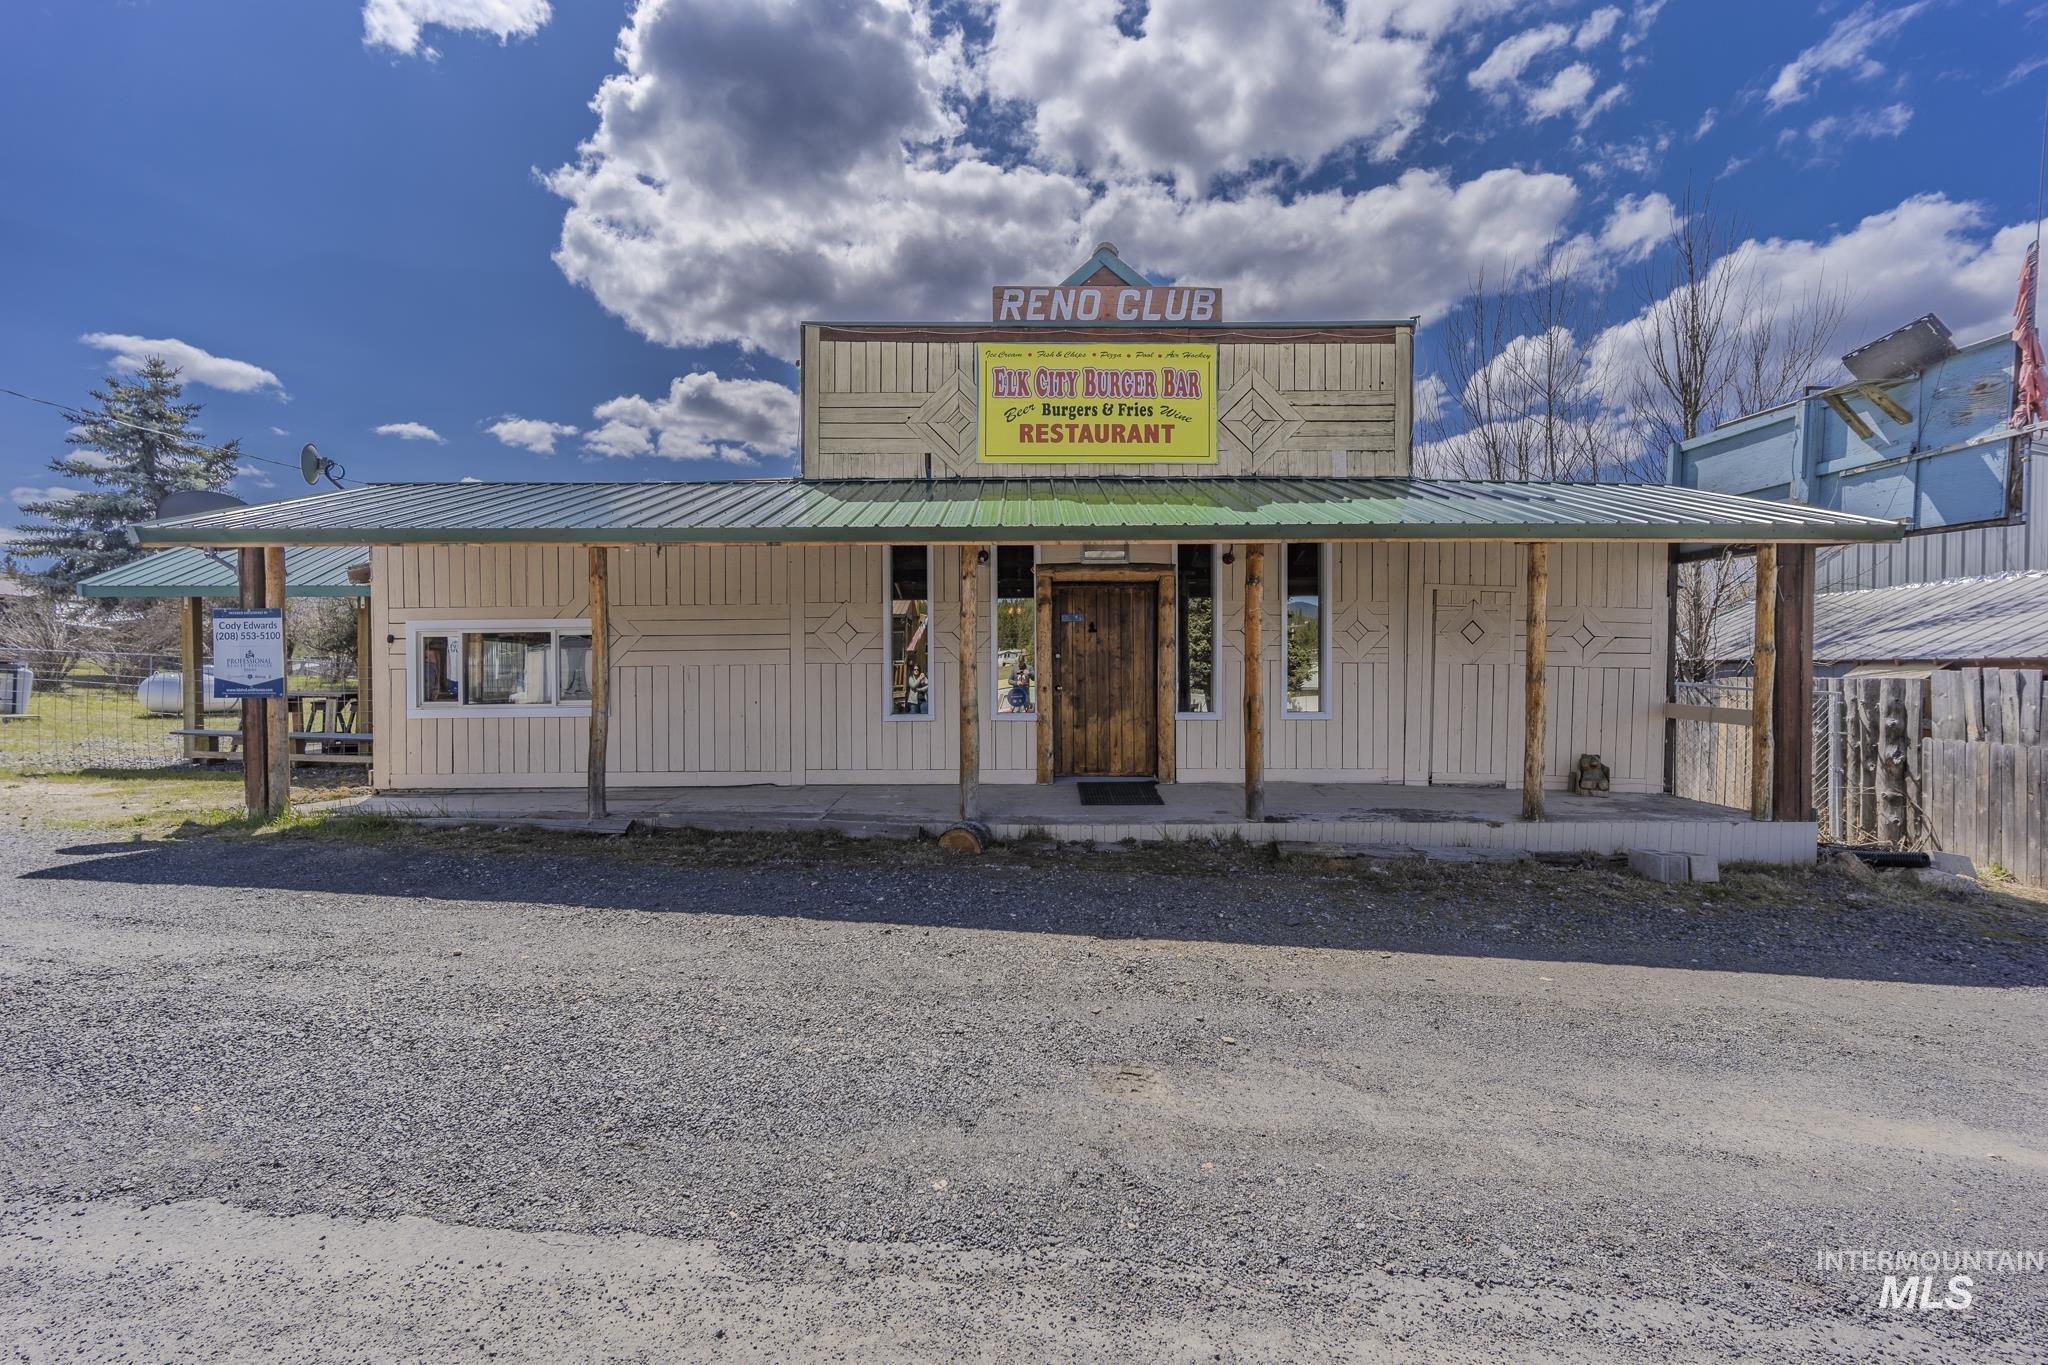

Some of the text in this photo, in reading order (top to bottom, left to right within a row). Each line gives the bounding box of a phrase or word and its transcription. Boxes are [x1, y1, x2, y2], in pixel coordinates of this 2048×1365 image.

[1000, 289, 1216, 321] RENO CLUB
[985, 350, 998, 359] Ice
[1037, 350, 1054, 358] Fish
[1100, 351, 1122, 359] Pizza
[1165, 350, 1179, 359] Air
[1182, 351, 1211, 360] Hockey
[1082, 366, 1158, 399] BURGER
[1161, 367, 1202, 400] BAR
[1003, 403, 1036, 423] Beer
[1042, 402, 1153, 420] Burgers & Fries
[1160, 405, 1192, 422] Wine
[1019, 424, 1175, 443] RESTAURANT
[218, 621, 278, 630] Cody Edwards
[215, 631, 281, 641] (208) 553-5100
